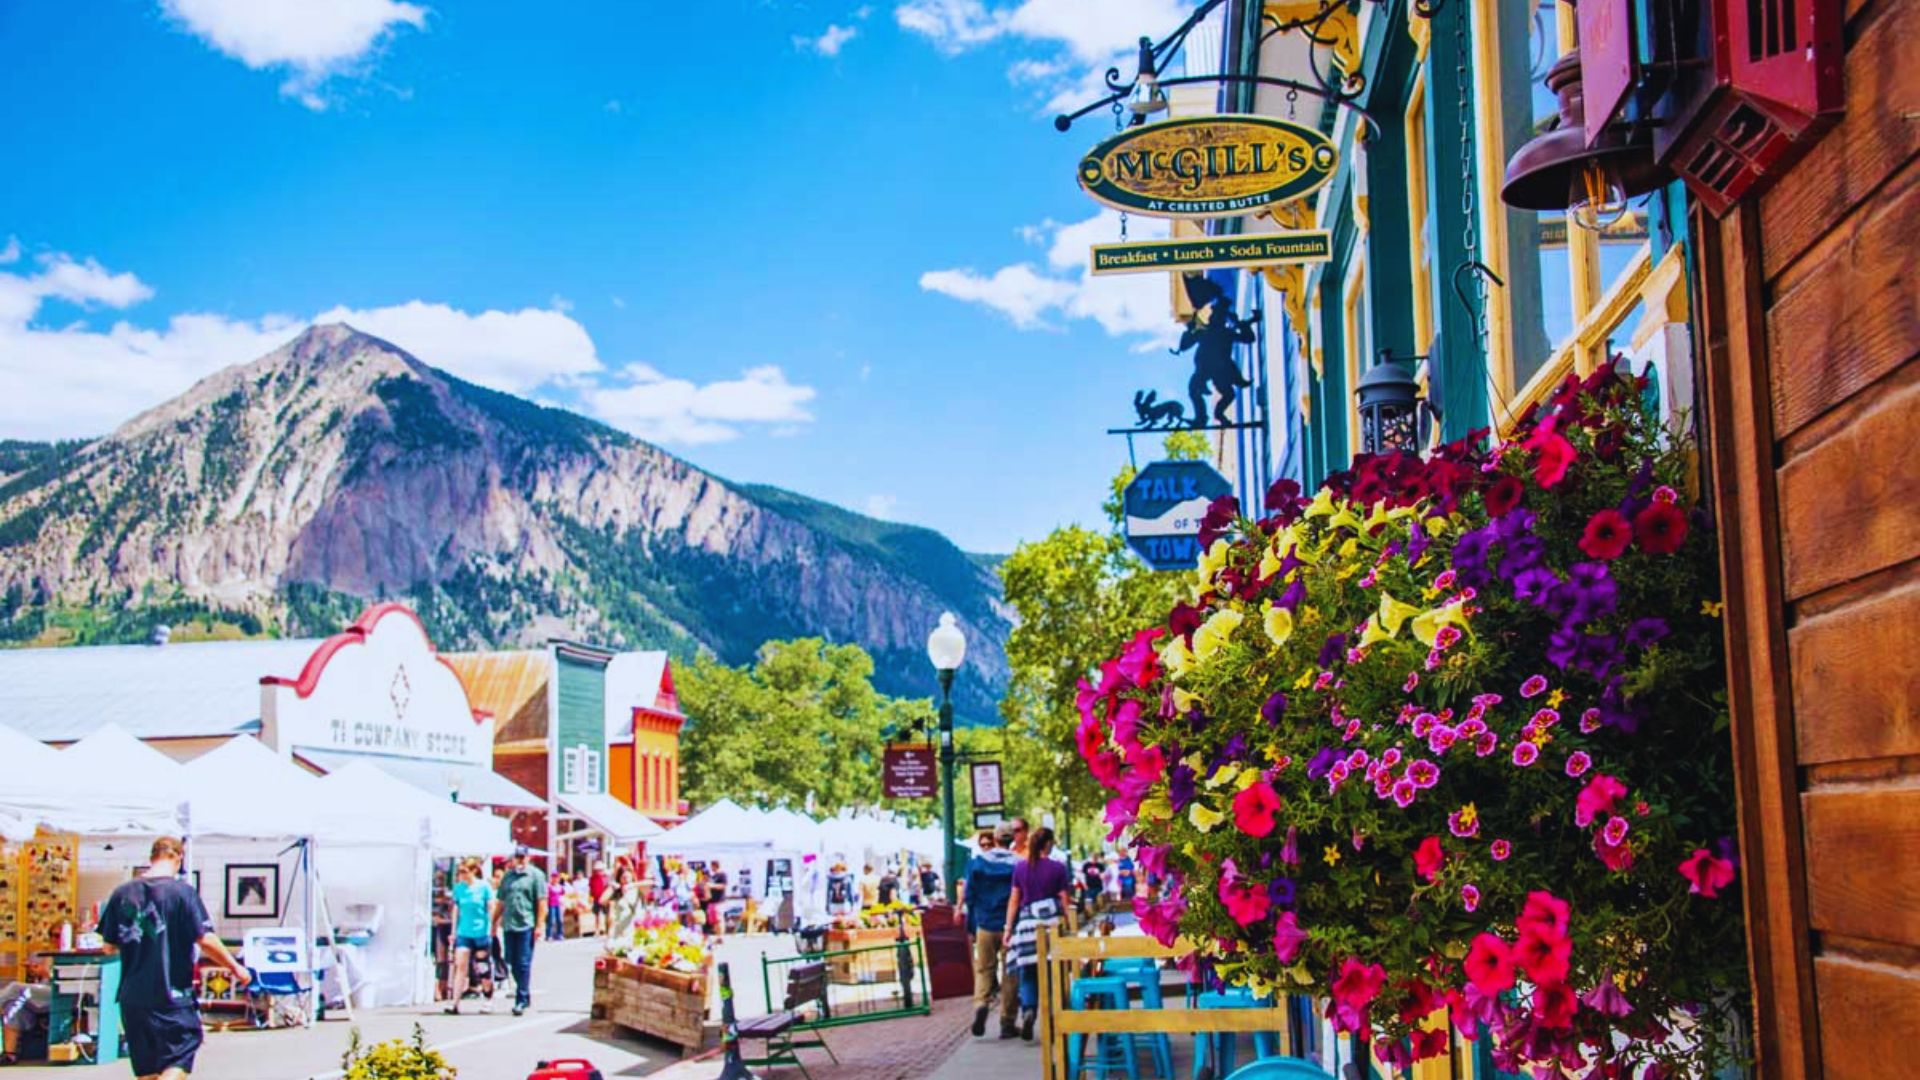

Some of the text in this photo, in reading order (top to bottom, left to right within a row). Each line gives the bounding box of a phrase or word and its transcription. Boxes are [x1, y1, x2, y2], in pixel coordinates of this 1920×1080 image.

[1148, 195, 1270, 212] AT CRESTED BUTTE
[1099, 241, 1324, 265] Breakfast Lunch Soda Fountain
[1137, 476, 1198, 501] TALK
[1173, 519, 1188, 529] OF
[354, 721, 420, 749] COMPANY
[427, 731, 467, 756] STORE
